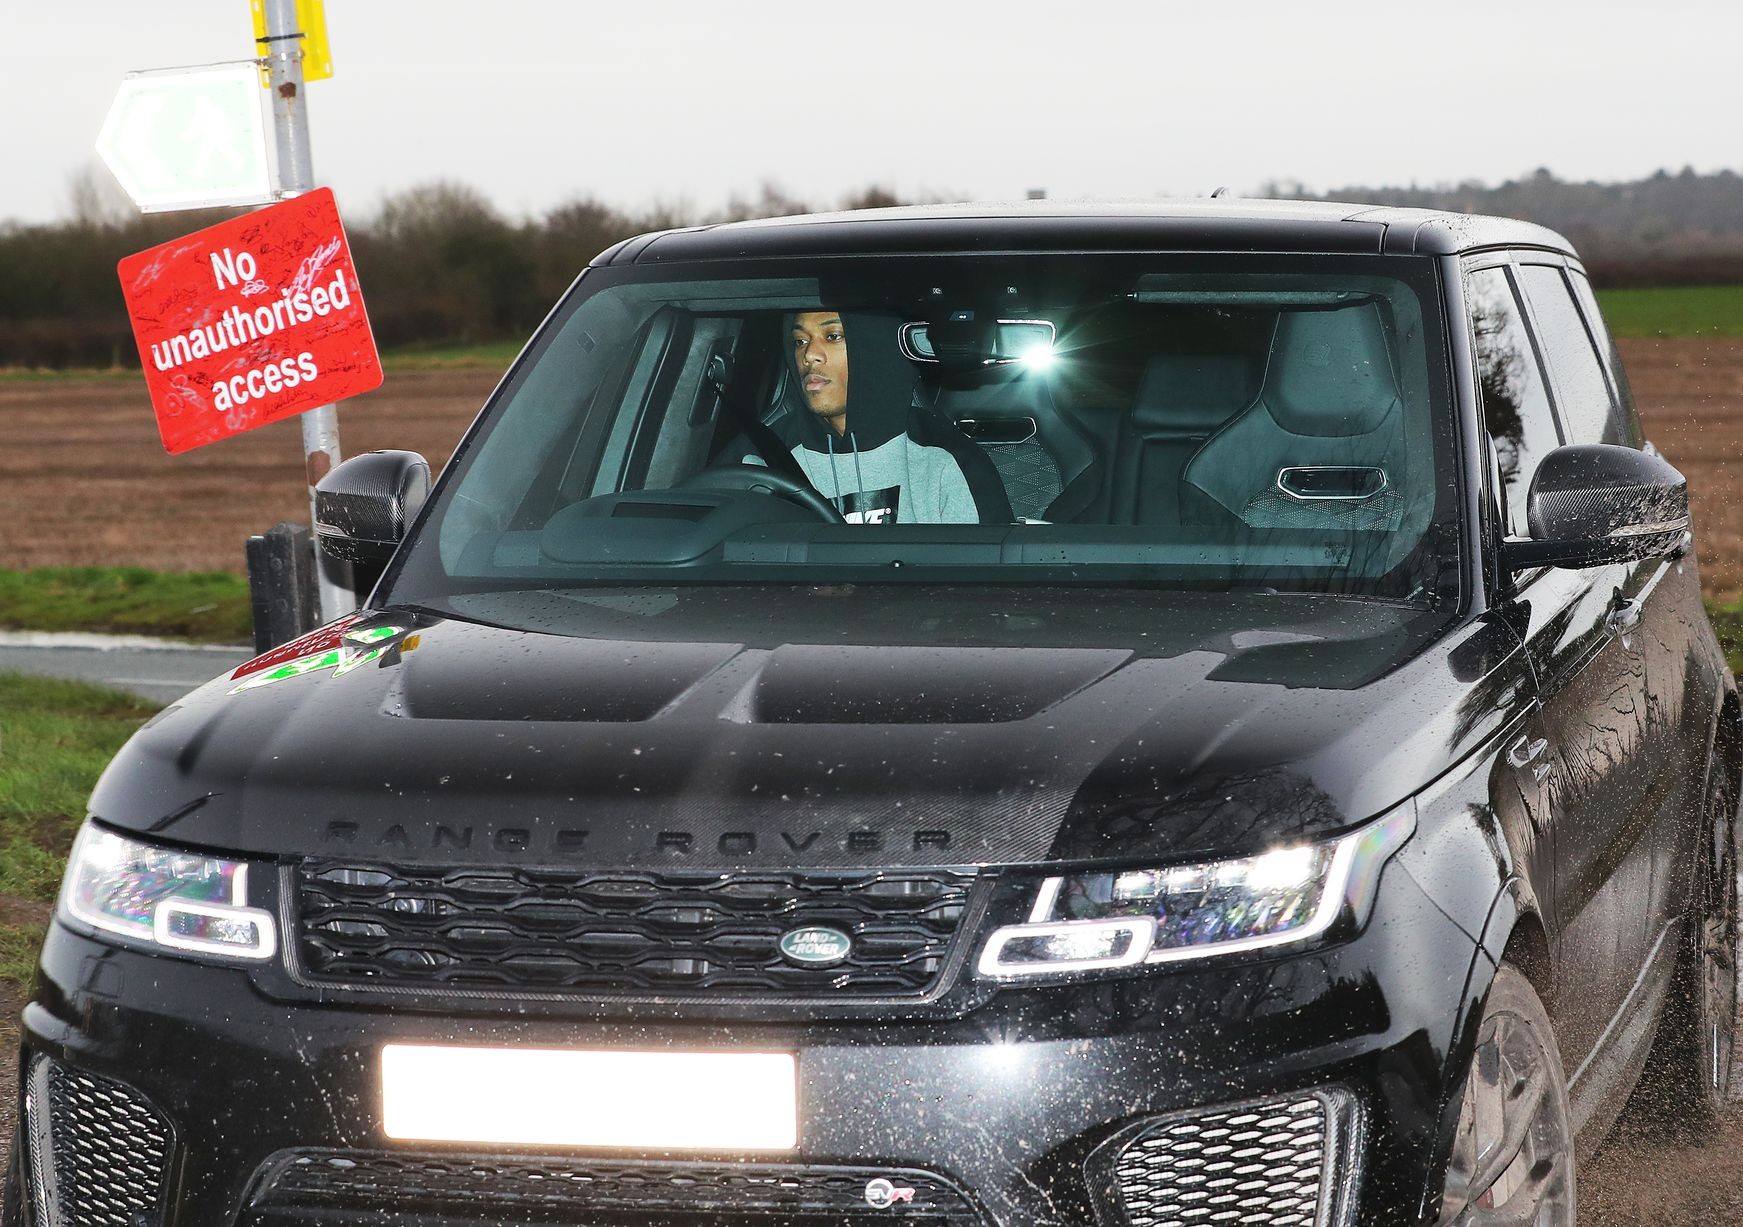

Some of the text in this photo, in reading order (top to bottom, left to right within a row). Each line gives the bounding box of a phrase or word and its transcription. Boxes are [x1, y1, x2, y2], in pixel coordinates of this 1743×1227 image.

[209, 247, 257, 290] No
[151, 269, 351, 371] unauthorised
[211, 352, 318, 411] access
[320, 820, 951, 856] RANGE ROVER
[793, 931, 830, 943] LAND
[795, 943, 839, 955] ROVER
